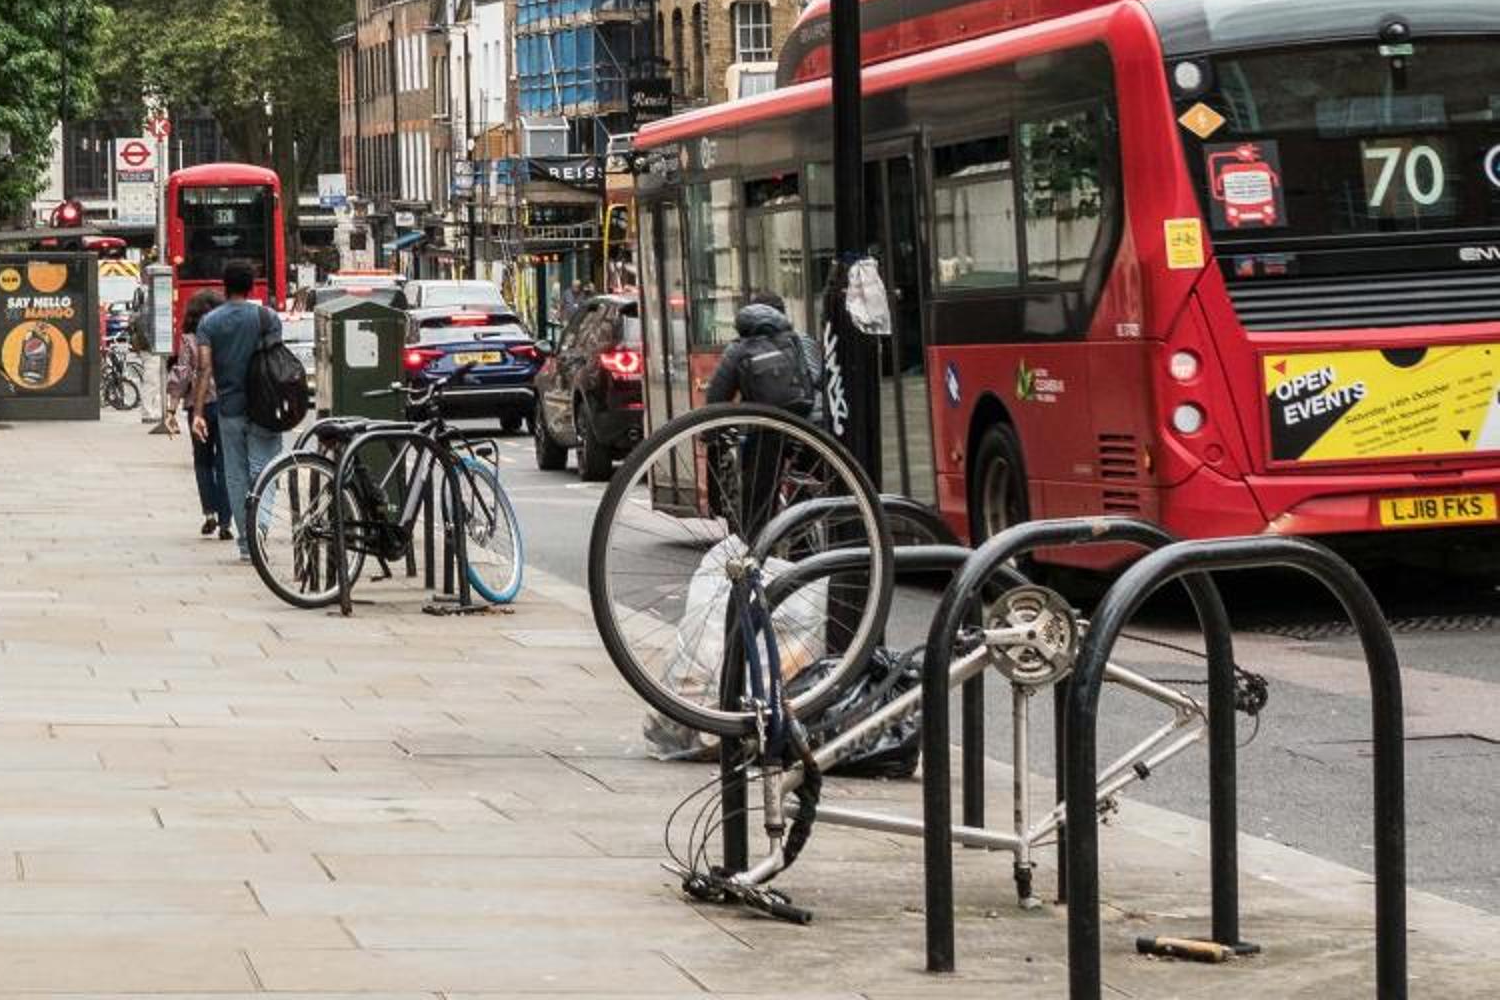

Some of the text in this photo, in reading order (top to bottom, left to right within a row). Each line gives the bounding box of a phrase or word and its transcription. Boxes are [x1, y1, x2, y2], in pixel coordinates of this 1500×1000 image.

[155, 120, 164, 134] K
[1363, 145, 1445, 207] 70
[7, 297, 31, 309] SAY
[24, 307, 74, 319] MANGO
[1276, 367, 1334, 401] OPEN
[1283, 381, 1367, 425] EVENTS
[1391, 497, 1484, 520] LJ18 FKS
